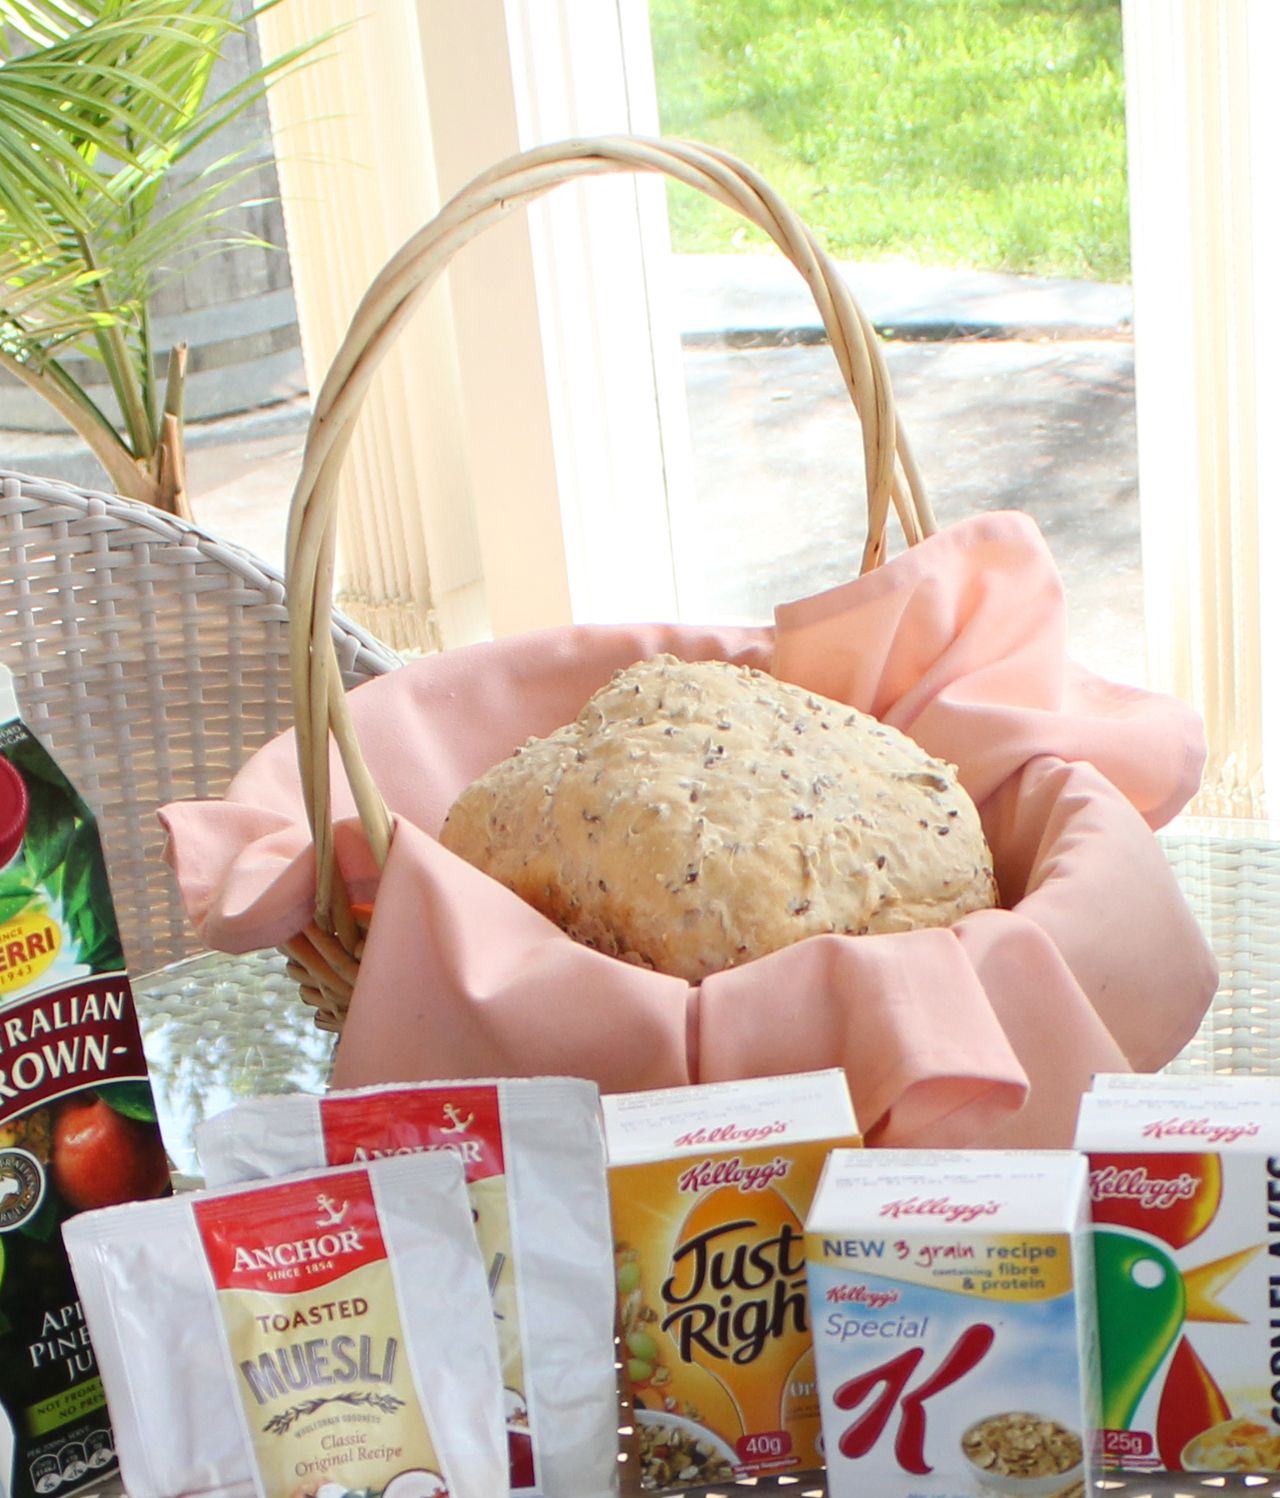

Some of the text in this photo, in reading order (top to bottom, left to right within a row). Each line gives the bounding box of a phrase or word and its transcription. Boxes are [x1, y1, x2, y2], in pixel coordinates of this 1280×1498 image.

[0, 965, 34, 985] 1943
[674, 1120, 789, 1148] Kellogg's
[1142, 1117, 1262, 1143] Kellogg's
[678, 1157, 790, 1194] Kellogg's
[1089, 1168, 1198, 1207] Kellogg's
[879, 1196, 1002, 1223] Kellogg's
[232, 1229, 364, 1272] ANCHOR
[660, 1219, 807, 1305] Just
[822, 1239, 1057, 1268] NEW 3 grain recipe
[266, 1268, 301, 1281] SINCE
[999, 1262, 1040, 1275] fibre
[825, 1283, 900, 1308] Kellogg's
[962, 1277, 1046, 1292] & protein
[256, 1297, 369, 1334] TOASTED
[660, 1279, 808, 1366] Righ
[825, 1313, 931, 1343] Special
[240, 1335, 398, 1405] MUESLI
[37, 1400, 61, 1416] NOT
[832, 1322, 997, 1477] K
[320, 1431, 368, 1451] Classic
[745, 1437, 782, 1456] 40g
[1106, 1431, 1142, 1454] 25g
[294, 1446, 404, 1478] Original Recipe
